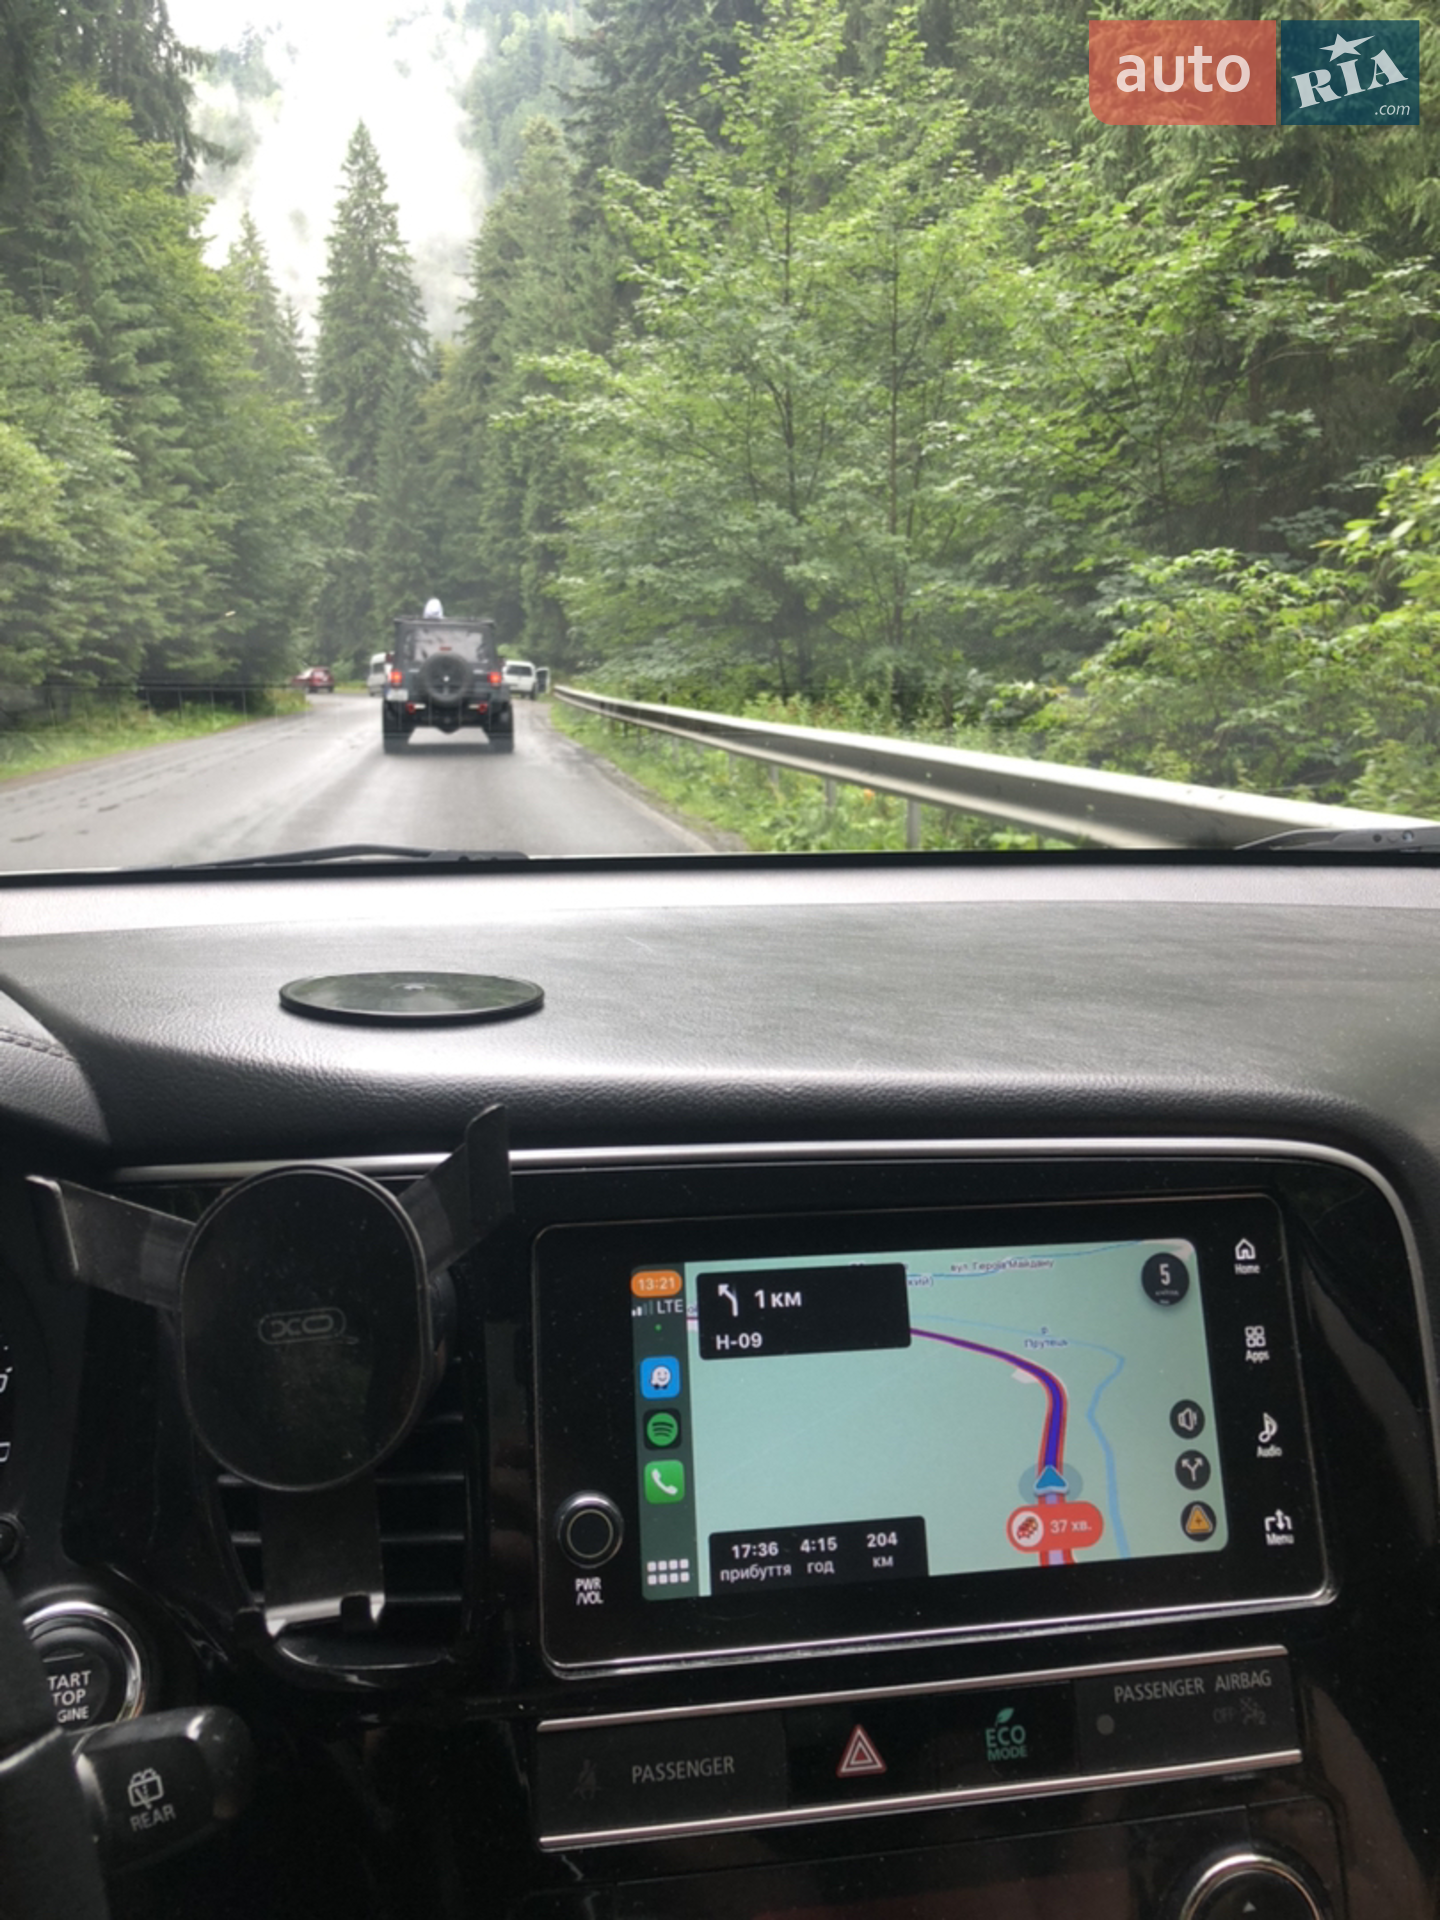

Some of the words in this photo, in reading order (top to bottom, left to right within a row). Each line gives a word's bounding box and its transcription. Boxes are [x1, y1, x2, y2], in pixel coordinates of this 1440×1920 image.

[1159, 1263, 1171, 1286] 5
[1234, 1263, 1261, 1275] Home
[638, 1276, 676, 1291] 13:21
[656, 1298, 684, 1315] LTE
[754, 1290, 766, 1309] 1
[1245, 1350, 1271, 1364] Apps
[1256, 1444, 1283, 1458] Audio
[1050, 1519, 1068, 1534] 37
[799, 1536, 839, 1554] 4:15
[866, 1531, 899, 1548] 204
[1266, 1532, 1294, 1546] Menu
[730, 1541, 780, 1560] 17:36
[719, 1562, 793, 1584] прибуття
[806, 1560, 835, 1575] год
[575, 1577, 602, 1591] PWR
[46, 1670, 93, 1692] TART
[1113, 1677, 1206, 1704] PASSENGER
[1214, 1669, 1273, 1693] AIRBAG
[51, 1688, 87, 1707] TOP
[57, 1705, 90, 1724] GINE
[985, 1725, 1027, 1749] ECO
[986, 1744, 1028, 1762] MODE
[631, 1755, 736, 1784] PASSENGER
[129, 1803, 177, 1832] REAR
